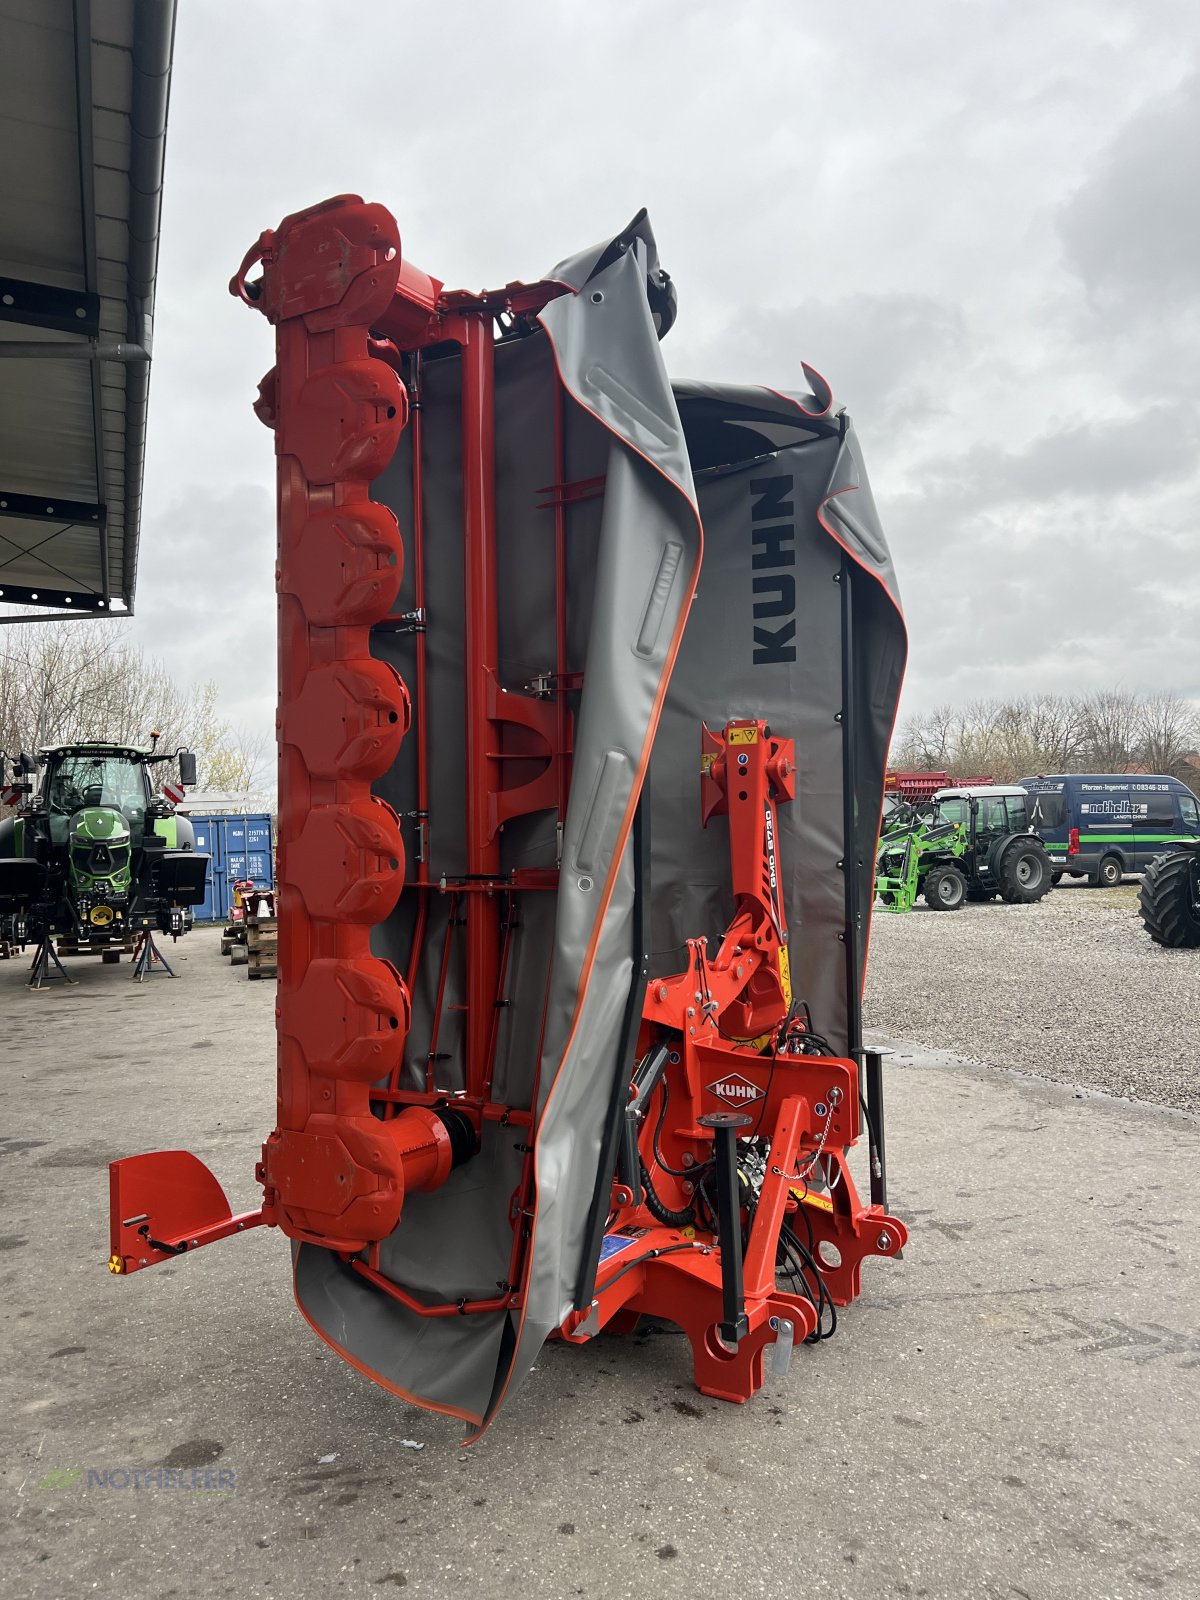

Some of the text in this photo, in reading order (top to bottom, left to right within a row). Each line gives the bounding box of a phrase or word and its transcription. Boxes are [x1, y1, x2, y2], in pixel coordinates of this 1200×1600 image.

[750, 475, 797, 665] KUHN
[1089, 800, 1141, 814] nothelfer
[765, 810, 774, 850] 8730
[716, 1084, 756, 1099] KUHN
